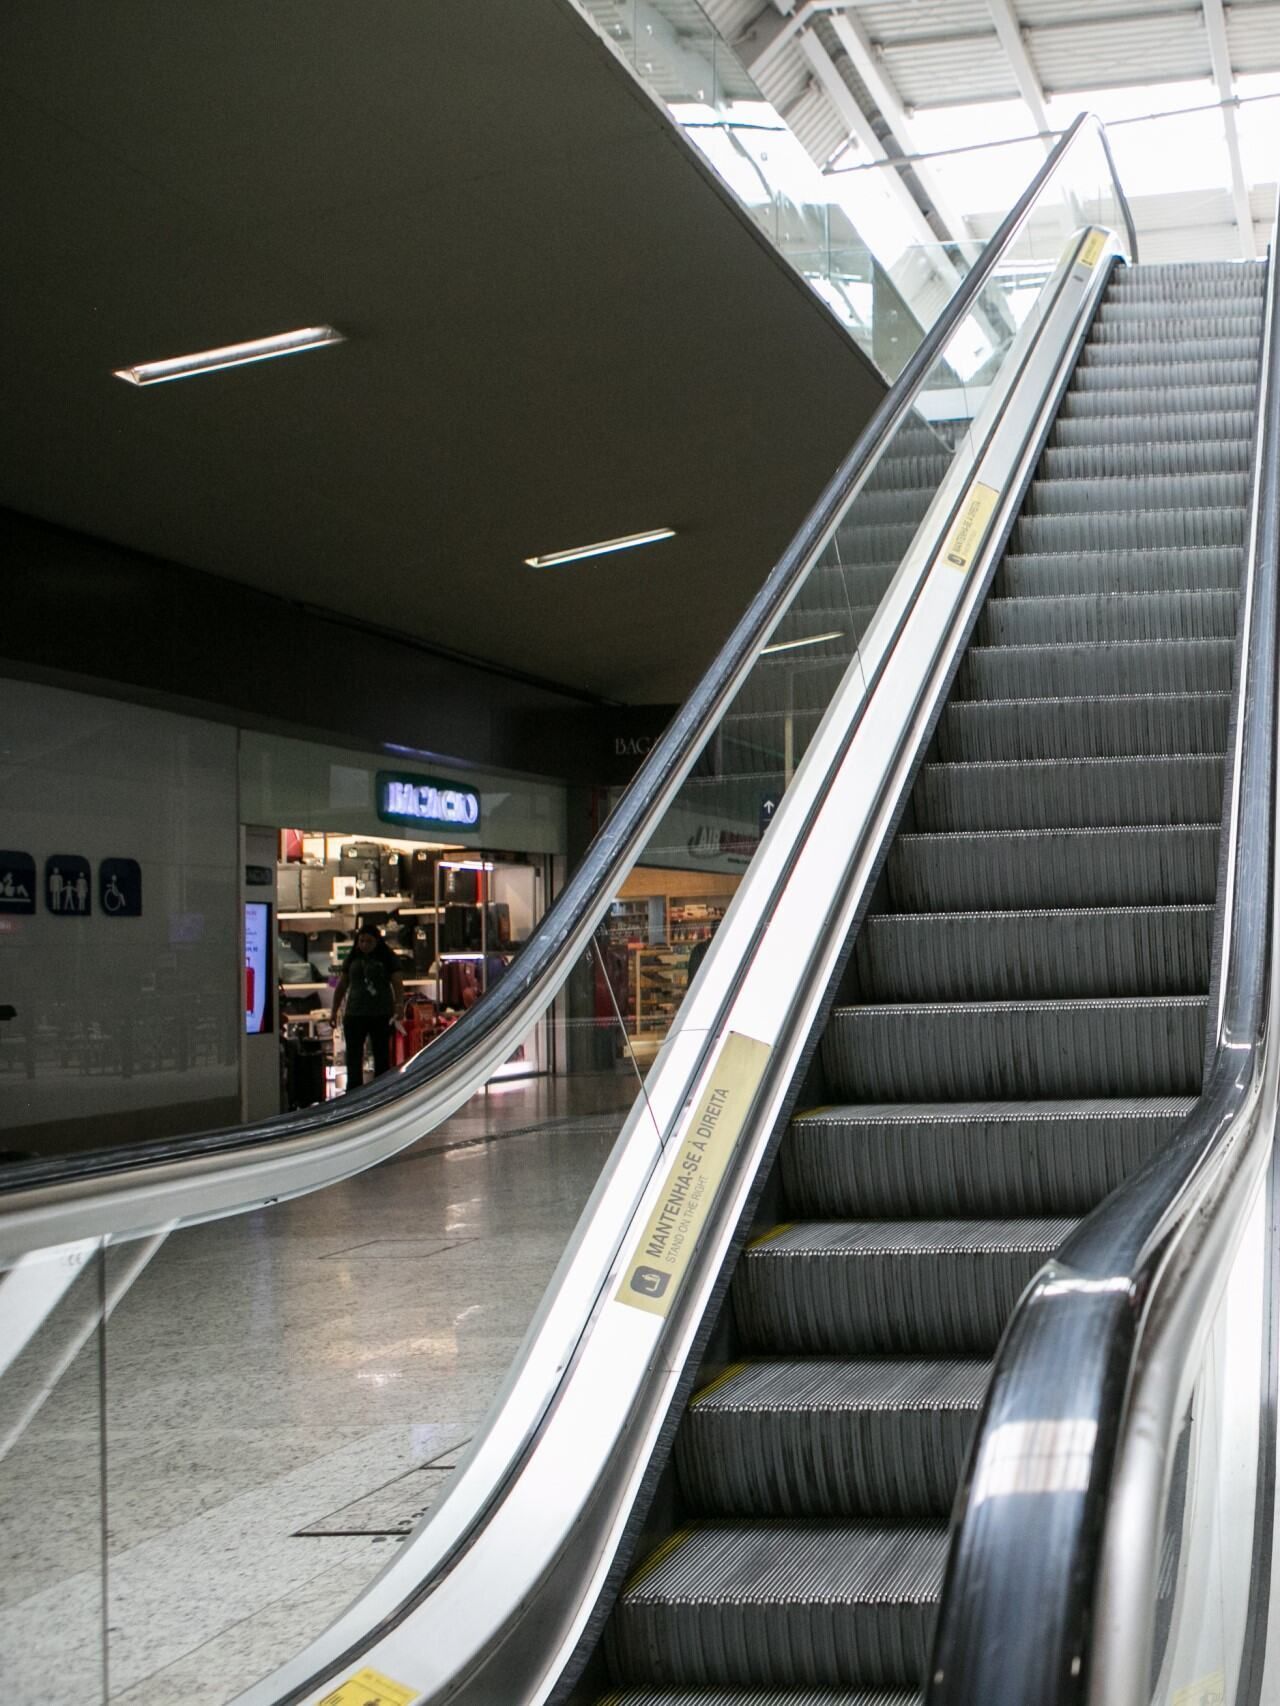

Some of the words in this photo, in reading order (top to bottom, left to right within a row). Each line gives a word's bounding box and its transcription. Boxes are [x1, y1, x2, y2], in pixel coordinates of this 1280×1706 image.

[696, 1088, 729, 1138] DIREITA
[688, 1140, 707, 1152] À
[692, 1175, 709, 1201] RIGHT
[646, 1152, 702, 1258] MANTENHA-SE
[684, 1202, 698, 1220] THE
[678, 1220, 691, 1233] ON
[665, 1235, 685, 1263] STAND
